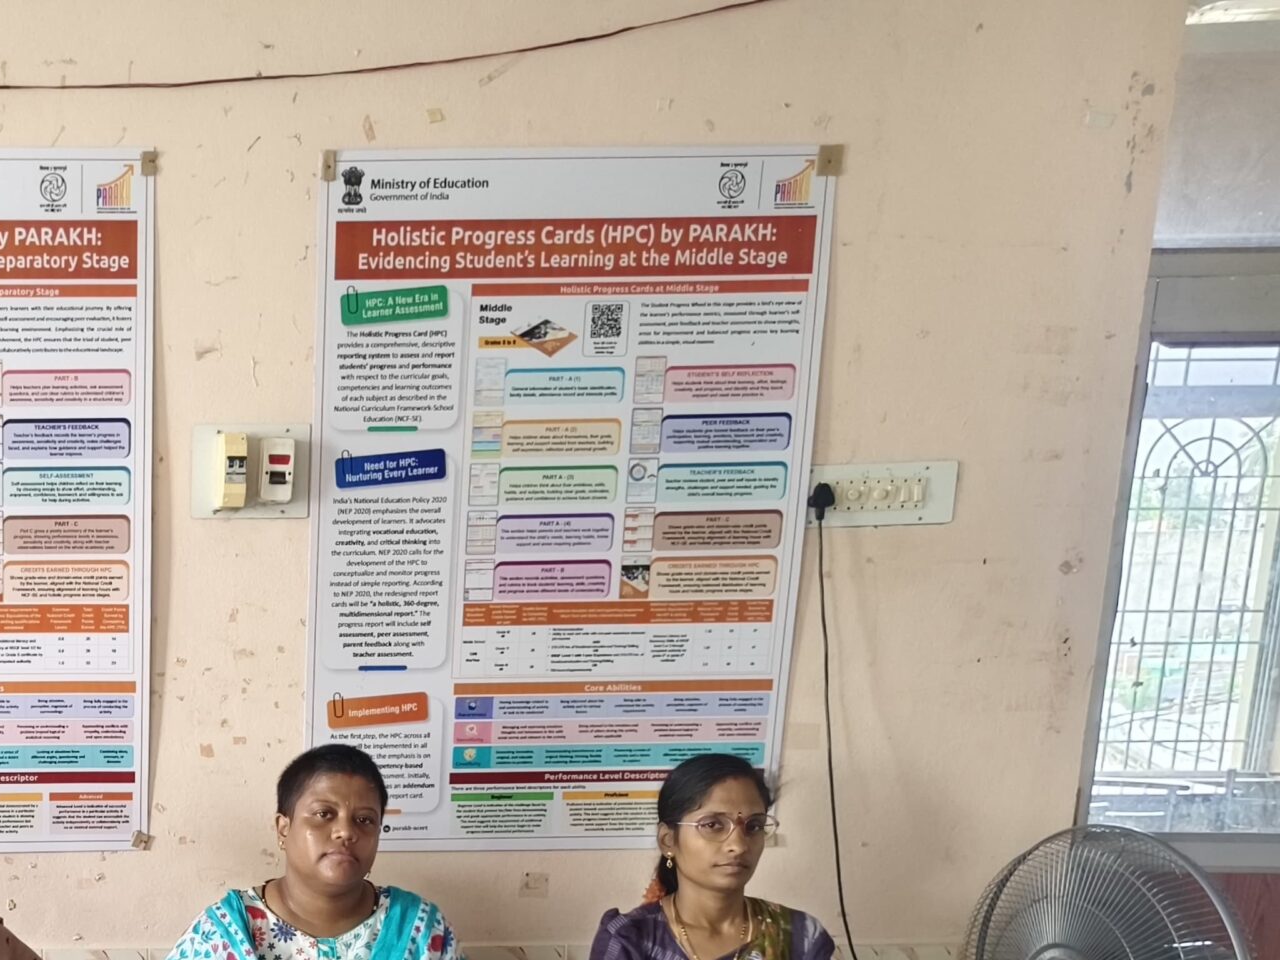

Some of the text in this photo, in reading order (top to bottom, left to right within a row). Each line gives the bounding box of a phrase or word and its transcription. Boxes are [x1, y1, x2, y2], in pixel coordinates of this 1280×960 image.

[370, 178, 488, 192] Ministry of Education
[369, 192, 449, 200] Government of India
[14, 226, 101, 245] PARAKH:
[372, 223, 776, 249] Holistic Progress Cards (HPC) by PARAKH:
[82, 252, 129, 273] Stage
[358, 252, 450, 273] Evidencing
[540, 250, 614, 271] Learning
[618, 249, 636, 266] at
[641, 249, 669, 266] the
[674, 249, 733, 265] Middle
[738, 248, 787, 268] Stage
[34, 287, 61, 297] Stage
[365, 298, 385, 307] HPC:
[395, 296, 413, 304] New
[414, 294, 428, 303] Era
[479, 303, 512, 312] Middle
[361, 302, 443, 317] Learner Assessment
[478, 315, 506, 326] Stage
[363, 458, 418, 470] Need for HPC:
[345, 467, 438, 482] Nurturing Every Learner
[337, 507, 352, 515] (NEP
[353, 507, 371, 515] 2020)
[371, 507, 407, 515] emphasizes
[348, 702, 417, 716] Implementing HPC
